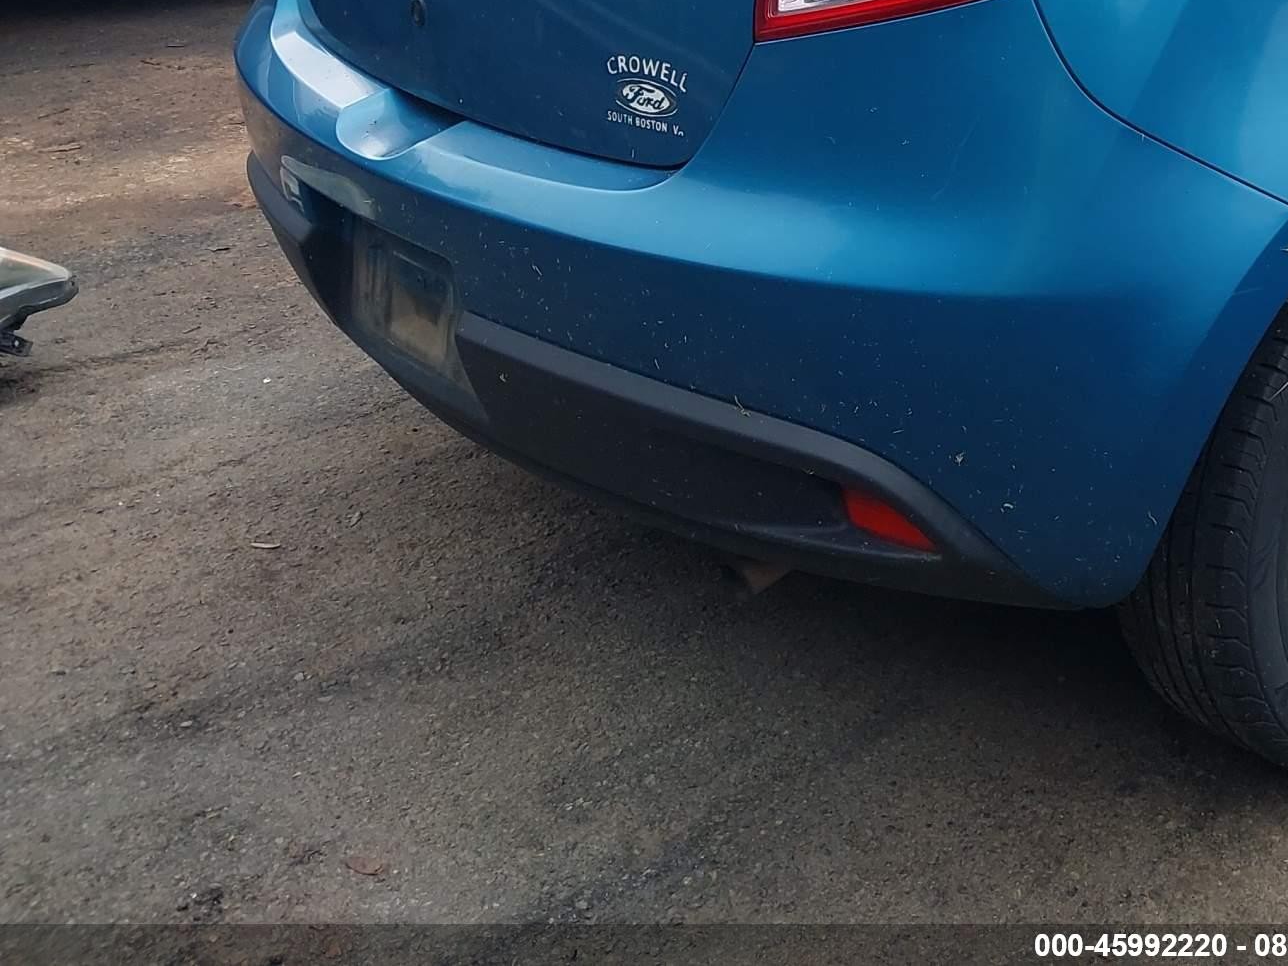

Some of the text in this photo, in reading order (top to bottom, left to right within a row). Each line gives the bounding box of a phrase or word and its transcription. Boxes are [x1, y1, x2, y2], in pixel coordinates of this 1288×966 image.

[607, 55, 688, 93] CROWELL
[624, 84, 668, 111] Ford
[607, 110, 633, 125] SOUTH
[635, 118, 668, 133] BOSTON
